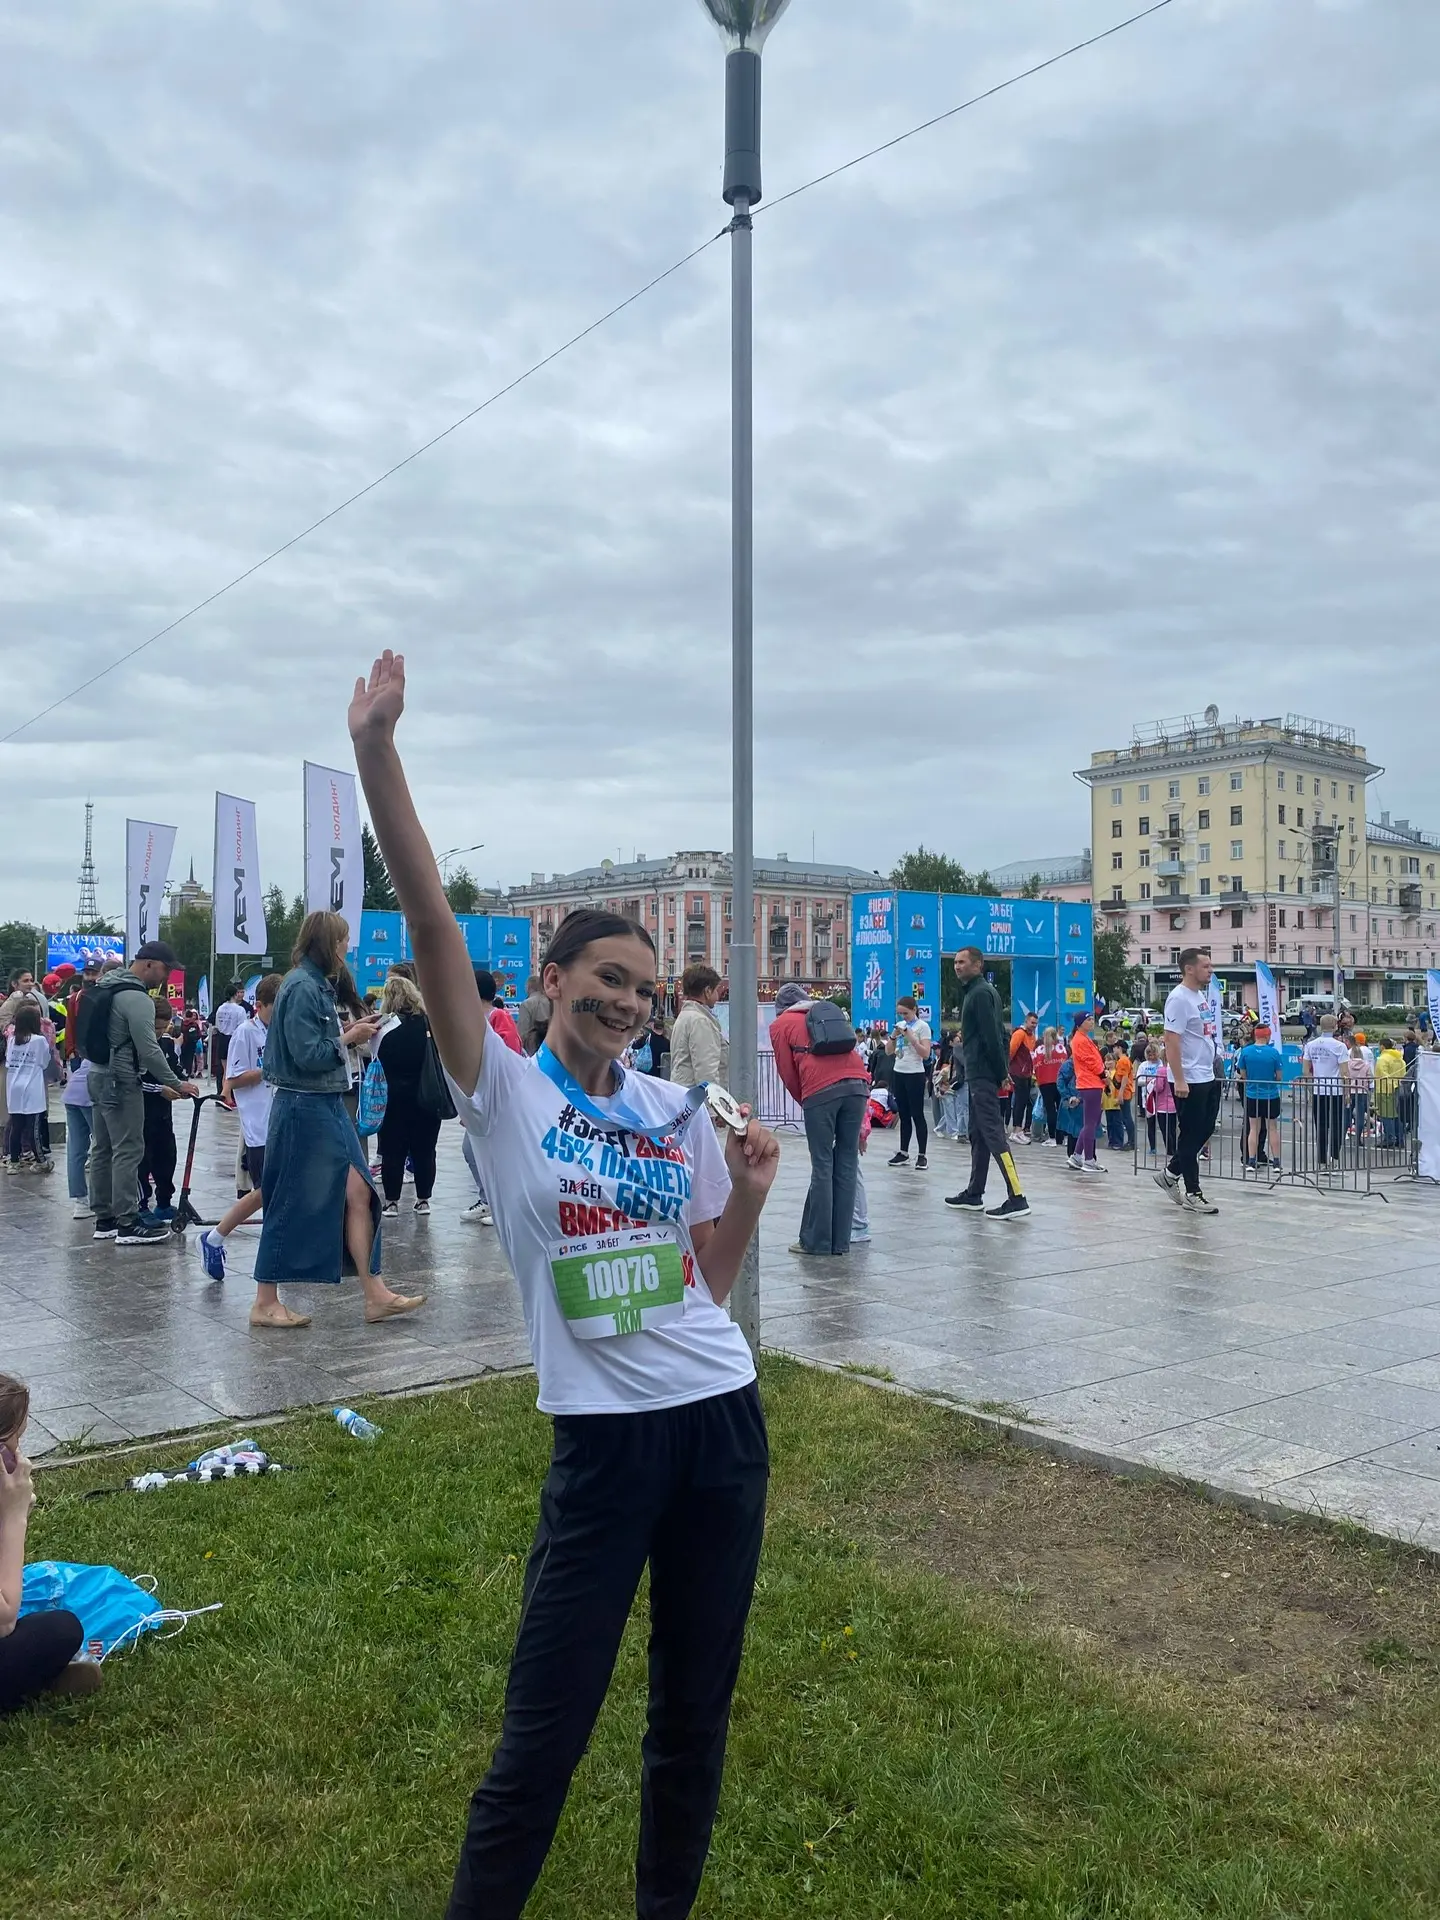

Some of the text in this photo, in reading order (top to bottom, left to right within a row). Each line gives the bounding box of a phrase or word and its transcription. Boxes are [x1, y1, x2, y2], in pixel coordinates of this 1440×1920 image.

[330, 779, 341, 840] ХОЛДИНГ
[143, 831, 154, 880] ХОЛДИНГ
[868, 898, 891, 913] #ЦЕЛЬ
[51, 934, 120, 946] КАМЧАТКА
[856, 930, 892, 945] #ЛЮБОВЬ
[986, 934, 1016, 952] СТАРТ
[376, 958, 394, 966] ПСБ
[915, 949, 932, 959] ПСБ
[1073, 956, 1087, 964] ПСБ
[541, 1126, 594, 1171] 45%
[616, 1182, 684, 1223] БЕГУТ
[558, 1200, 648, 1238] ВМЕС
[569, 1243, 588, 1253] ПСБ
[582, 1253, 660, 1301] 10076
